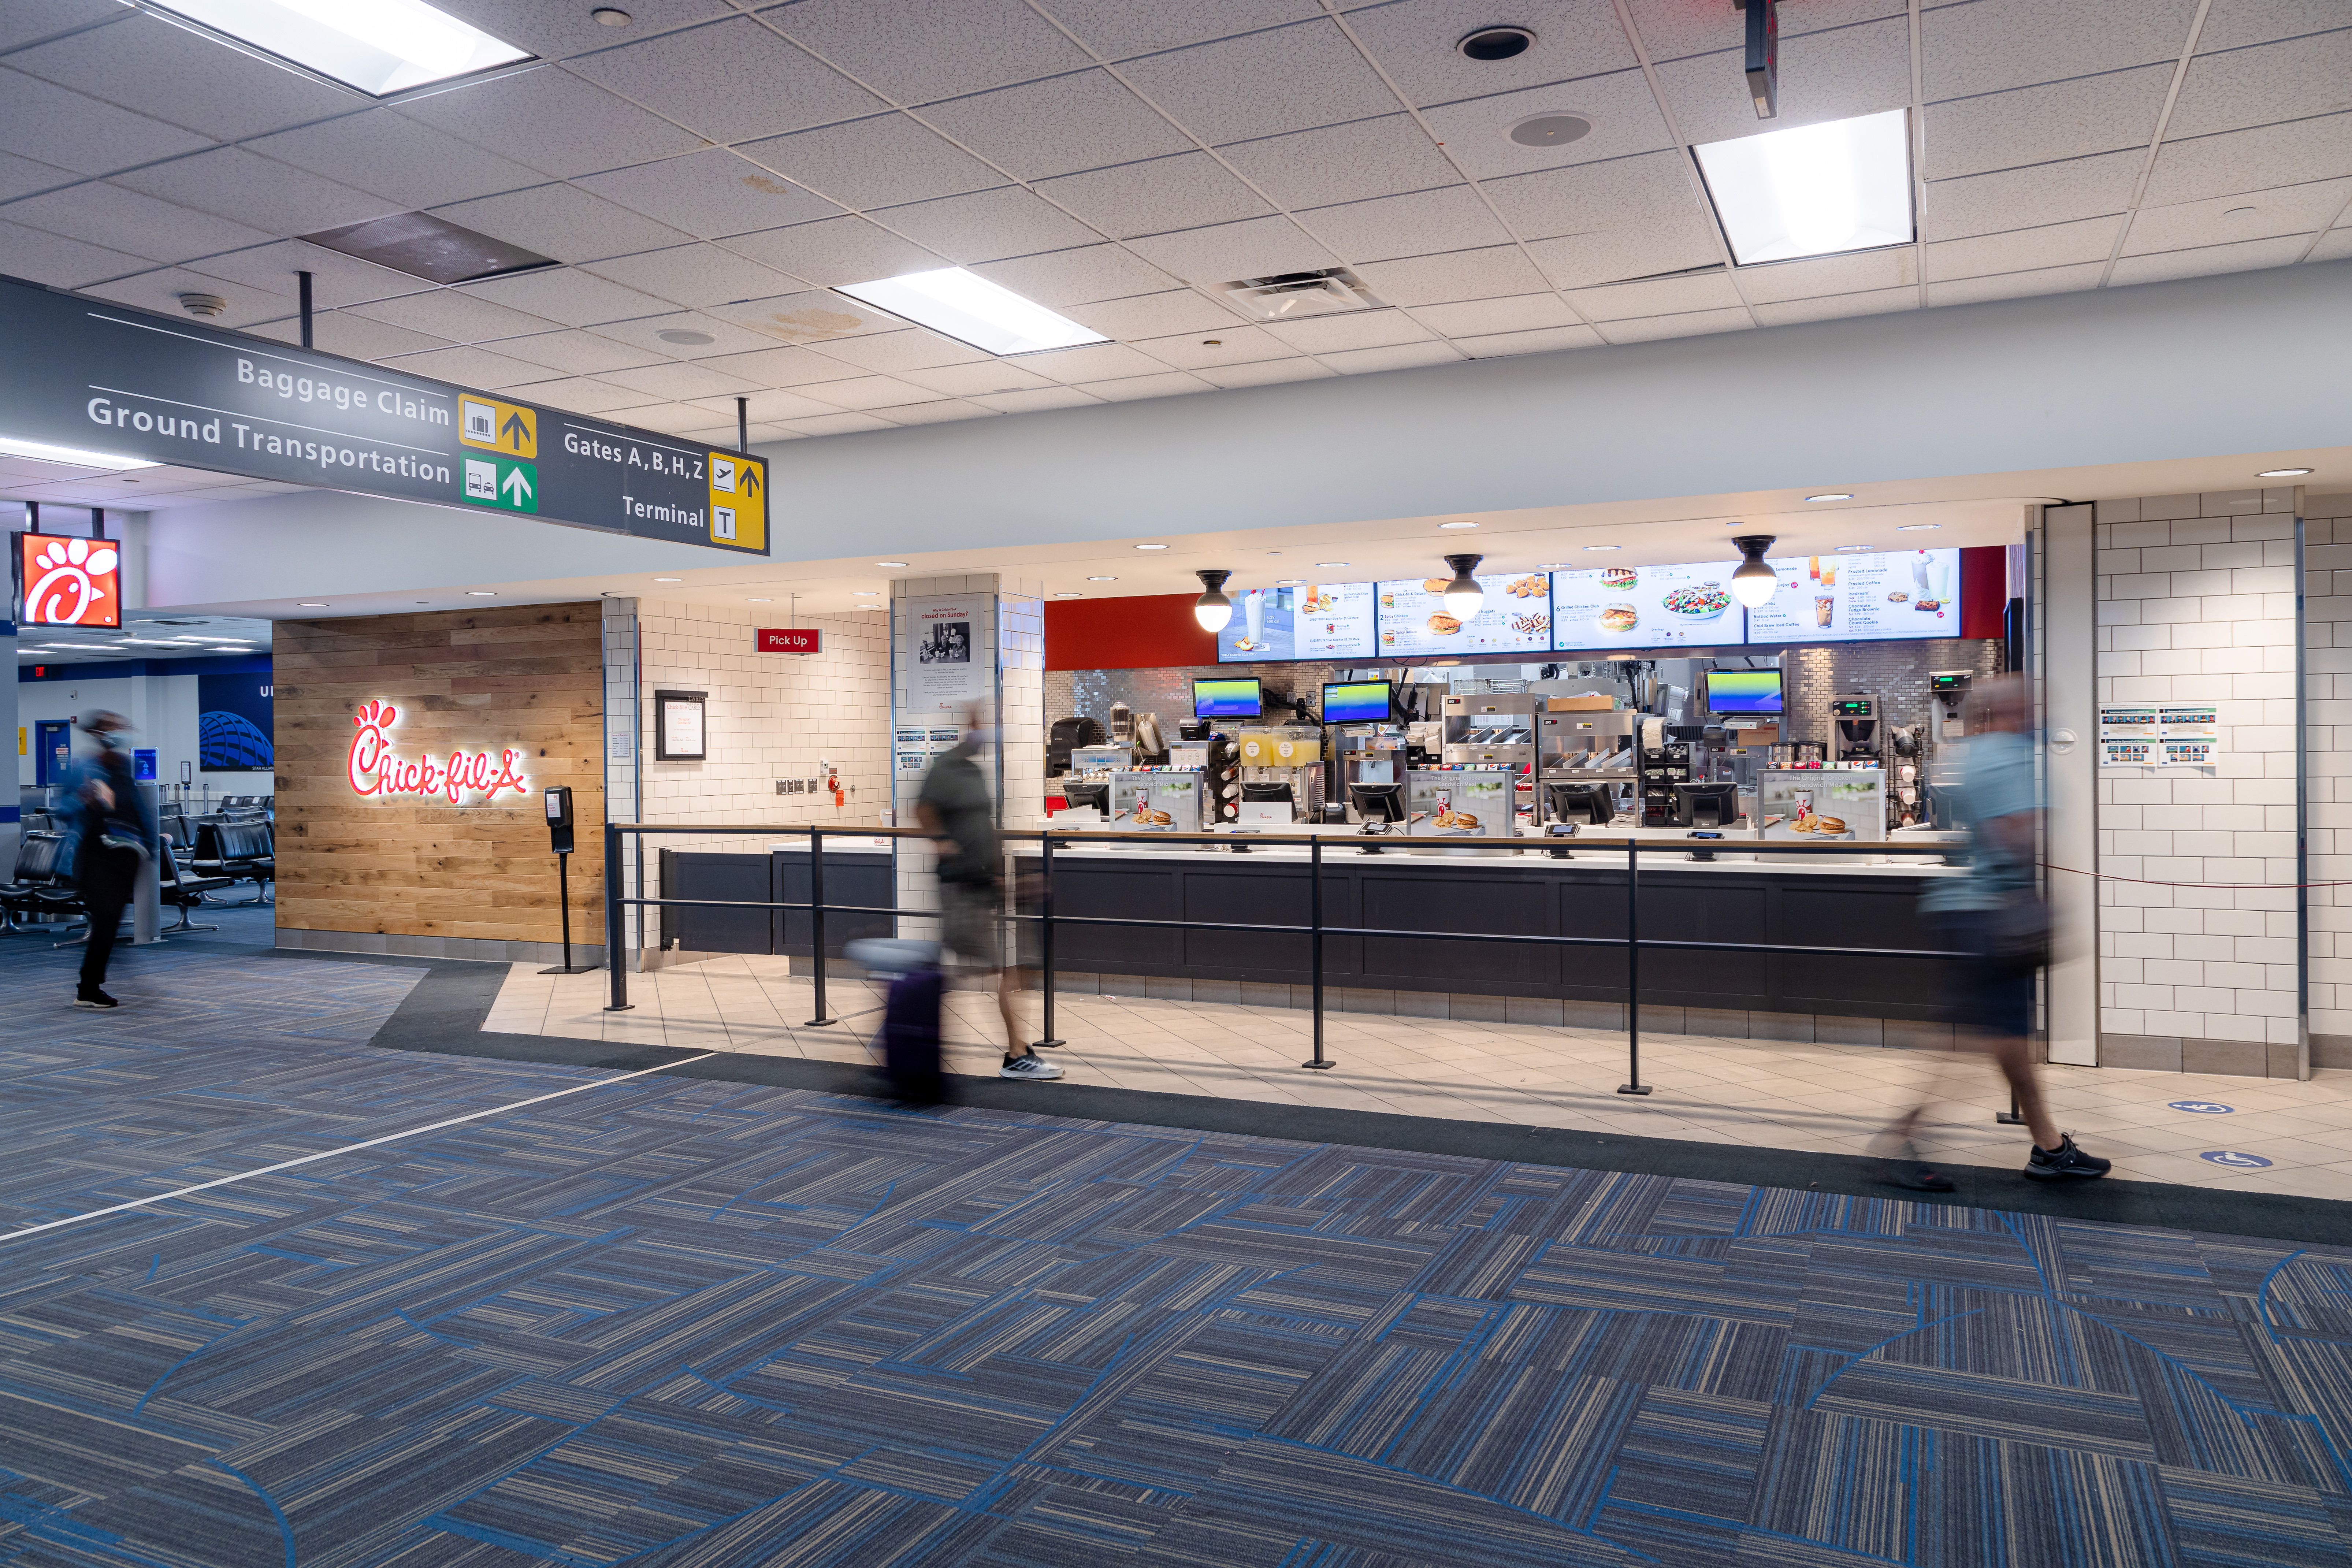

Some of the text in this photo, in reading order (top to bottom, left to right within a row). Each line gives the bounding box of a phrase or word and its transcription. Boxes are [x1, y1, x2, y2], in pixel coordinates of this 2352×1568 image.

[237, 358, 449, 426] Baggage Claim
[88, 398, 450, 484] Ground Transportation
[564, 433, 621, 462] Gates
[623, 496, 703, 527] Terminal
[719, 512, 731, 534] T
[770, 636, 807, 647] Pick Up
[36, 667, 44, 676] EXIT
